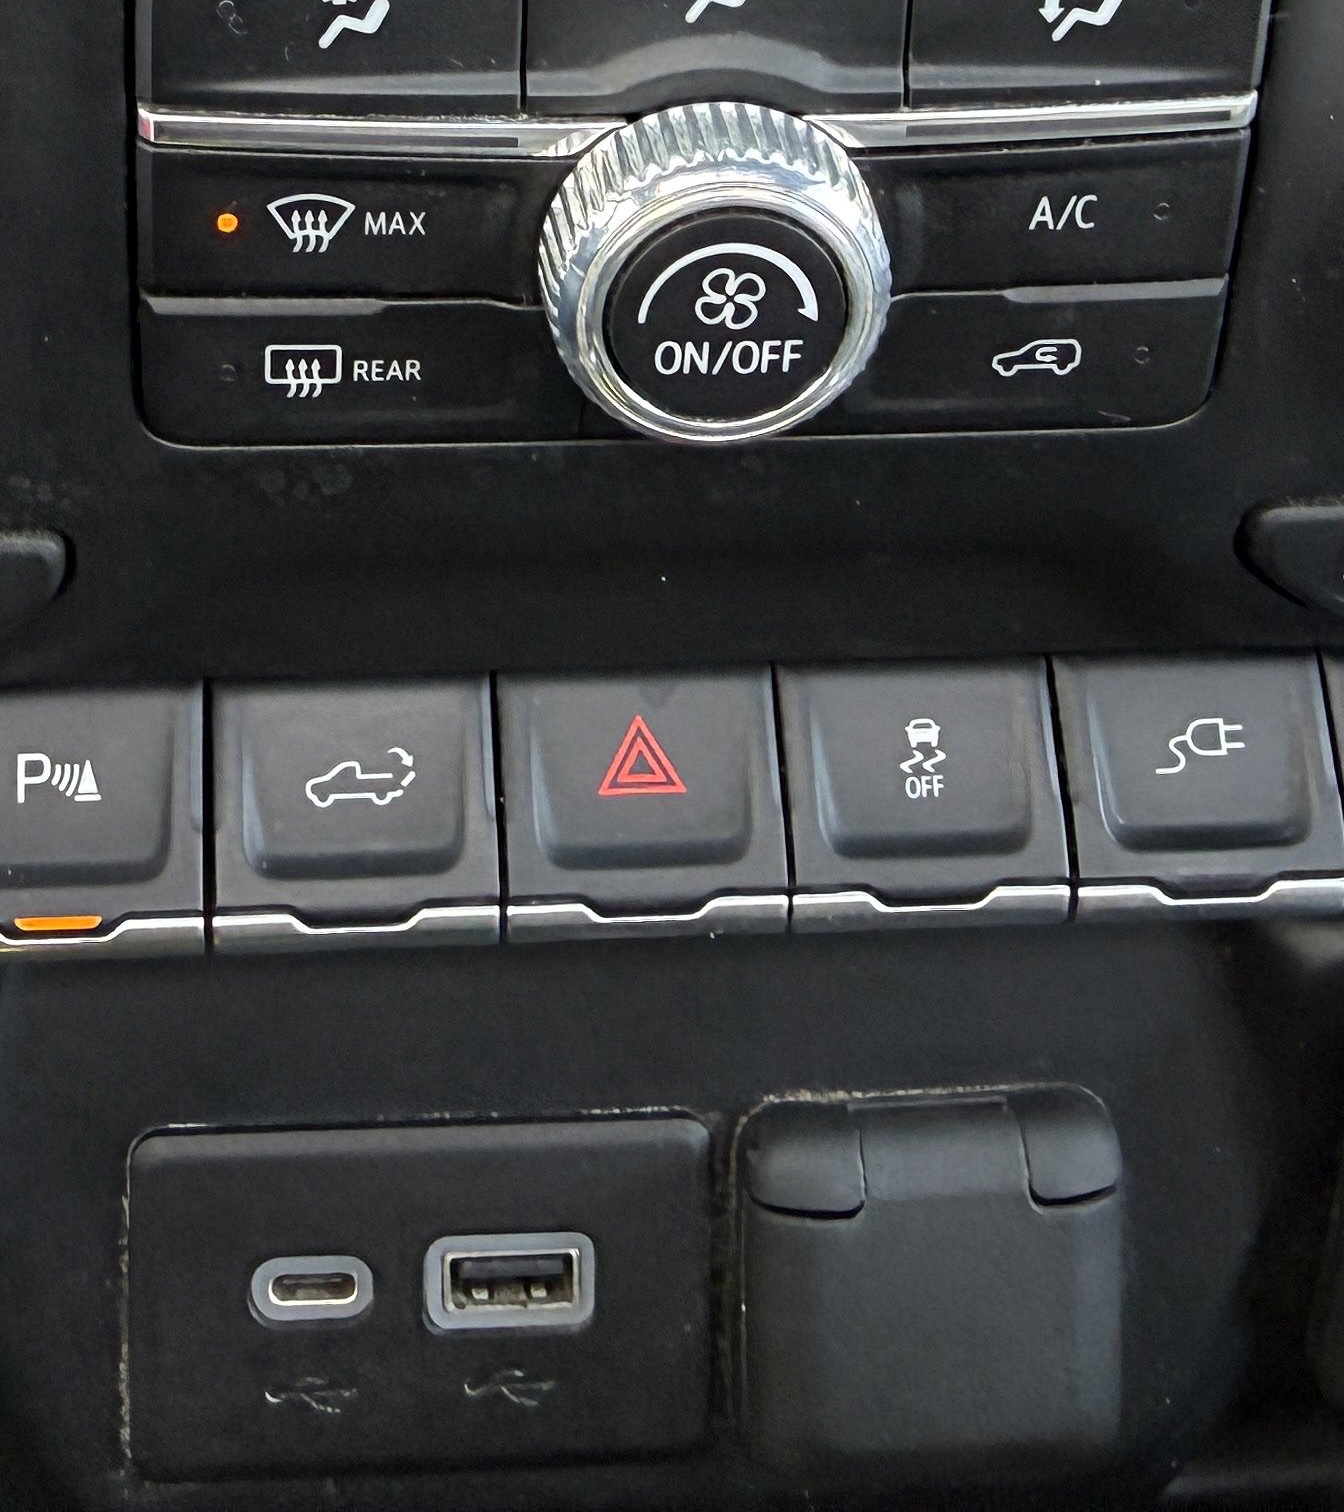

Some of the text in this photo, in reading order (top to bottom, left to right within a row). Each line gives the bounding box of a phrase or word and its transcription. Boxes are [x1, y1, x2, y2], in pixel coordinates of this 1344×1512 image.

[364, 211, 426, 236] MAX
[1029, 195, 1098, 231] A/C
[353, 359, 422, 382] REAR
[654, 339, 804, 376] ON/OFF
[905, 773, 947, 800] OFF
